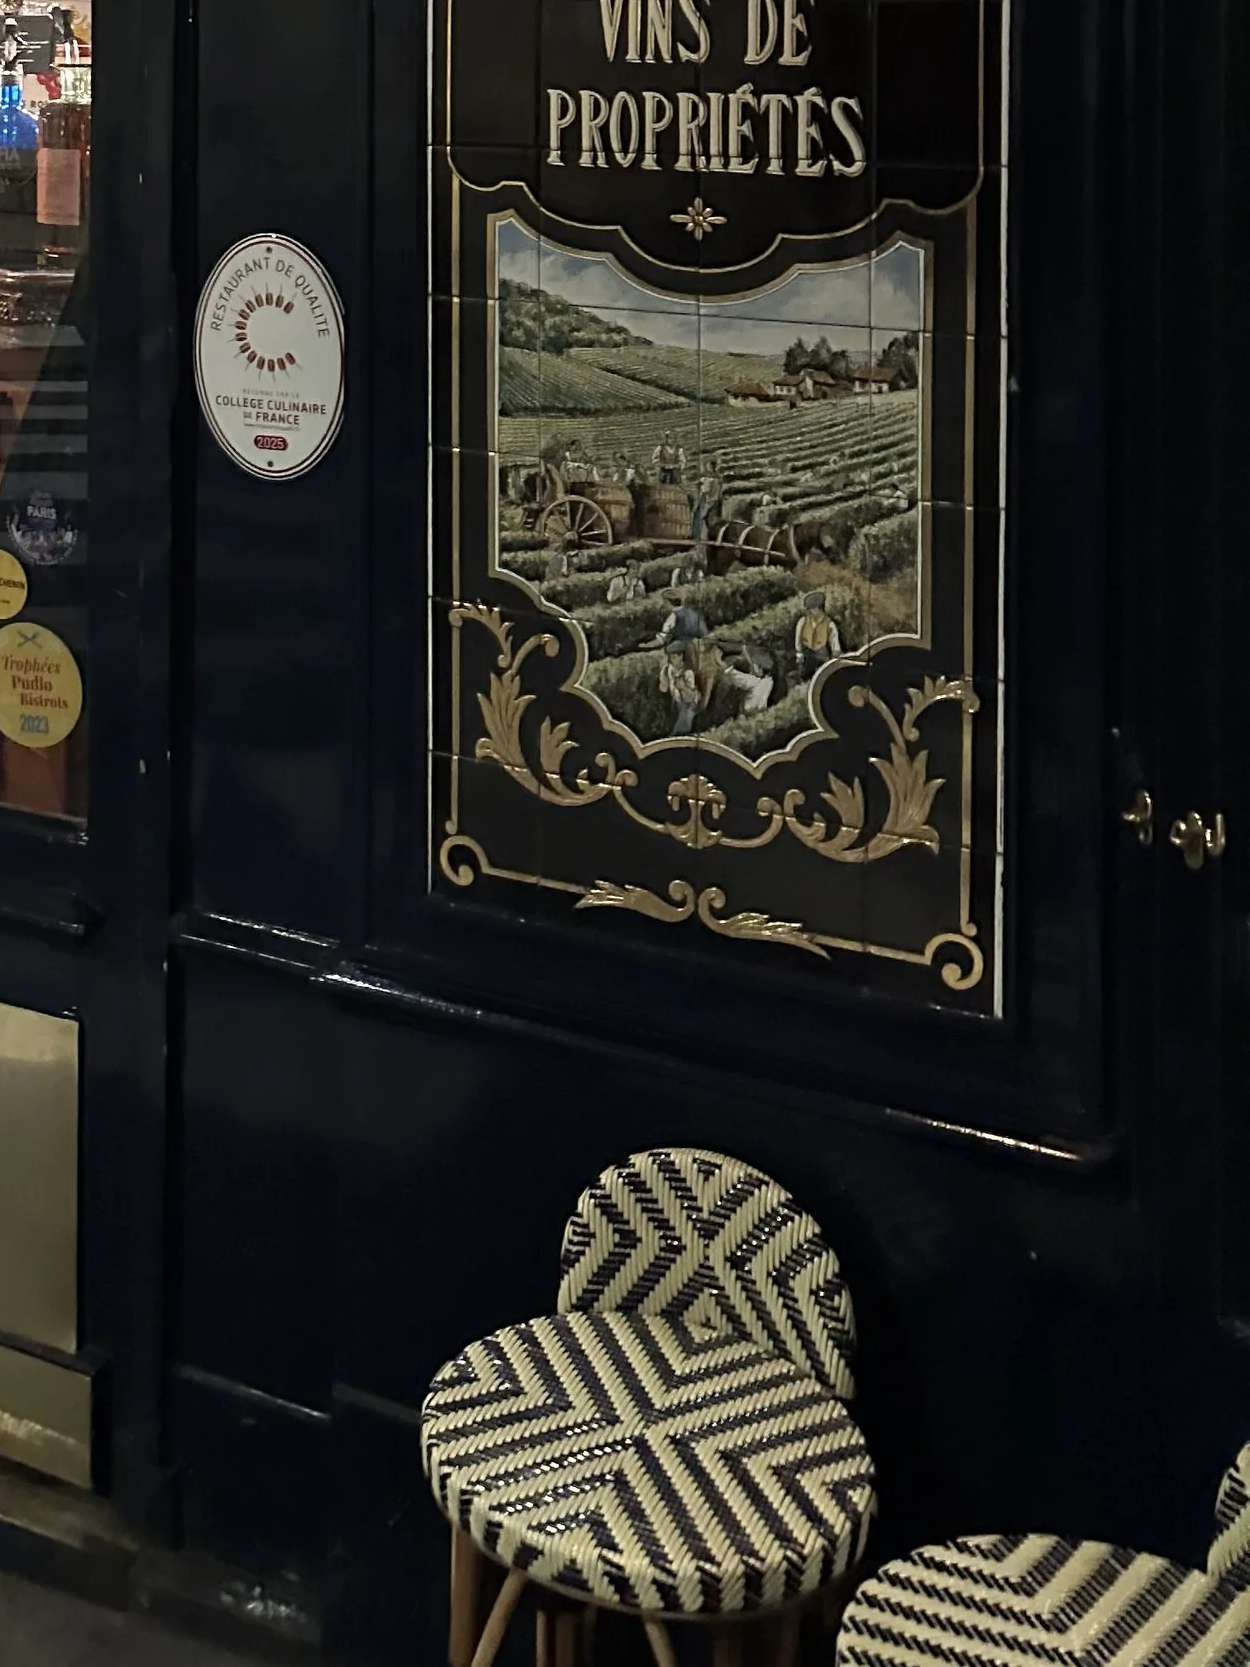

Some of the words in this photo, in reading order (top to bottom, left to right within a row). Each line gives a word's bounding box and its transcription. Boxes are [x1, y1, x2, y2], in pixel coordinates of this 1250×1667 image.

[546, 82, 867, 178] PROPRIÉTÉS
[210, 256, 272, 332] RESTAURANT
[275, 259, 295, 279] DE
[267, 400, 327, 415] CULINAIRE
[255, 411, 301, 426] FRANCE
[256, 436, 286, 450] 2025
[27, 505, 57, 520] PARIS
[2, 654, 61, 675] Trophées
[11, 675, 53, 692] Pudlo
[20, 692, 69, 710] Bistrots
